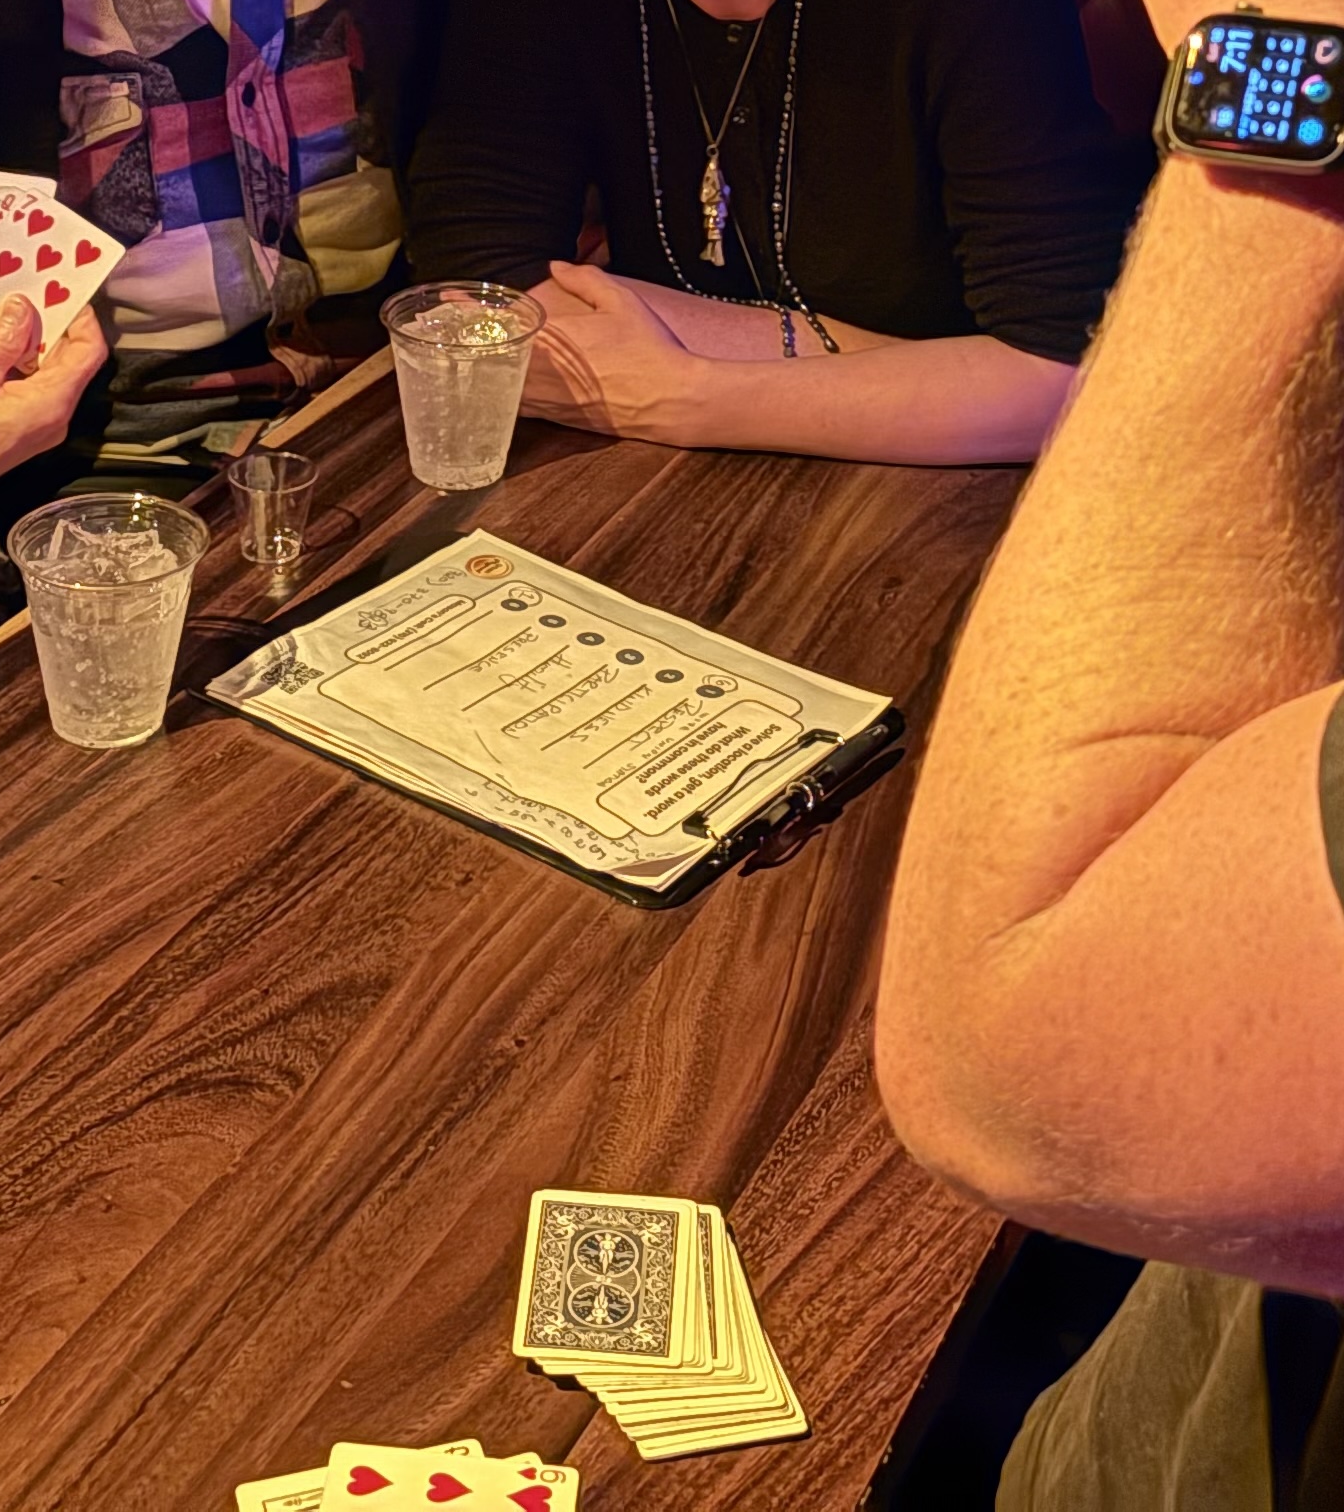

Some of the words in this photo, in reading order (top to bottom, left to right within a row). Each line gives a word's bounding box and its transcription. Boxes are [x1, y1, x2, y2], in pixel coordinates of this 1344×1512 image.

[1219, 29, 1254, 73] 7:11
[1, 194, 16, 211] Q
[21, 194, 38, 209] 7
[704, 721, 728, 739] have
[722, 725, 752, 747] What
[754, 723, 782, 746] Solve
[688, 740, 704, 752] in
[707, 744, 722, 756] do
[636, 745, 688, 784] common?
[680, 753, 708, 775] these
[700, 749, 750, 780] location,
[644, 773, 680, 797] words
[685, 777, 703, 795] get
[642, 797, 678, 820] word.
